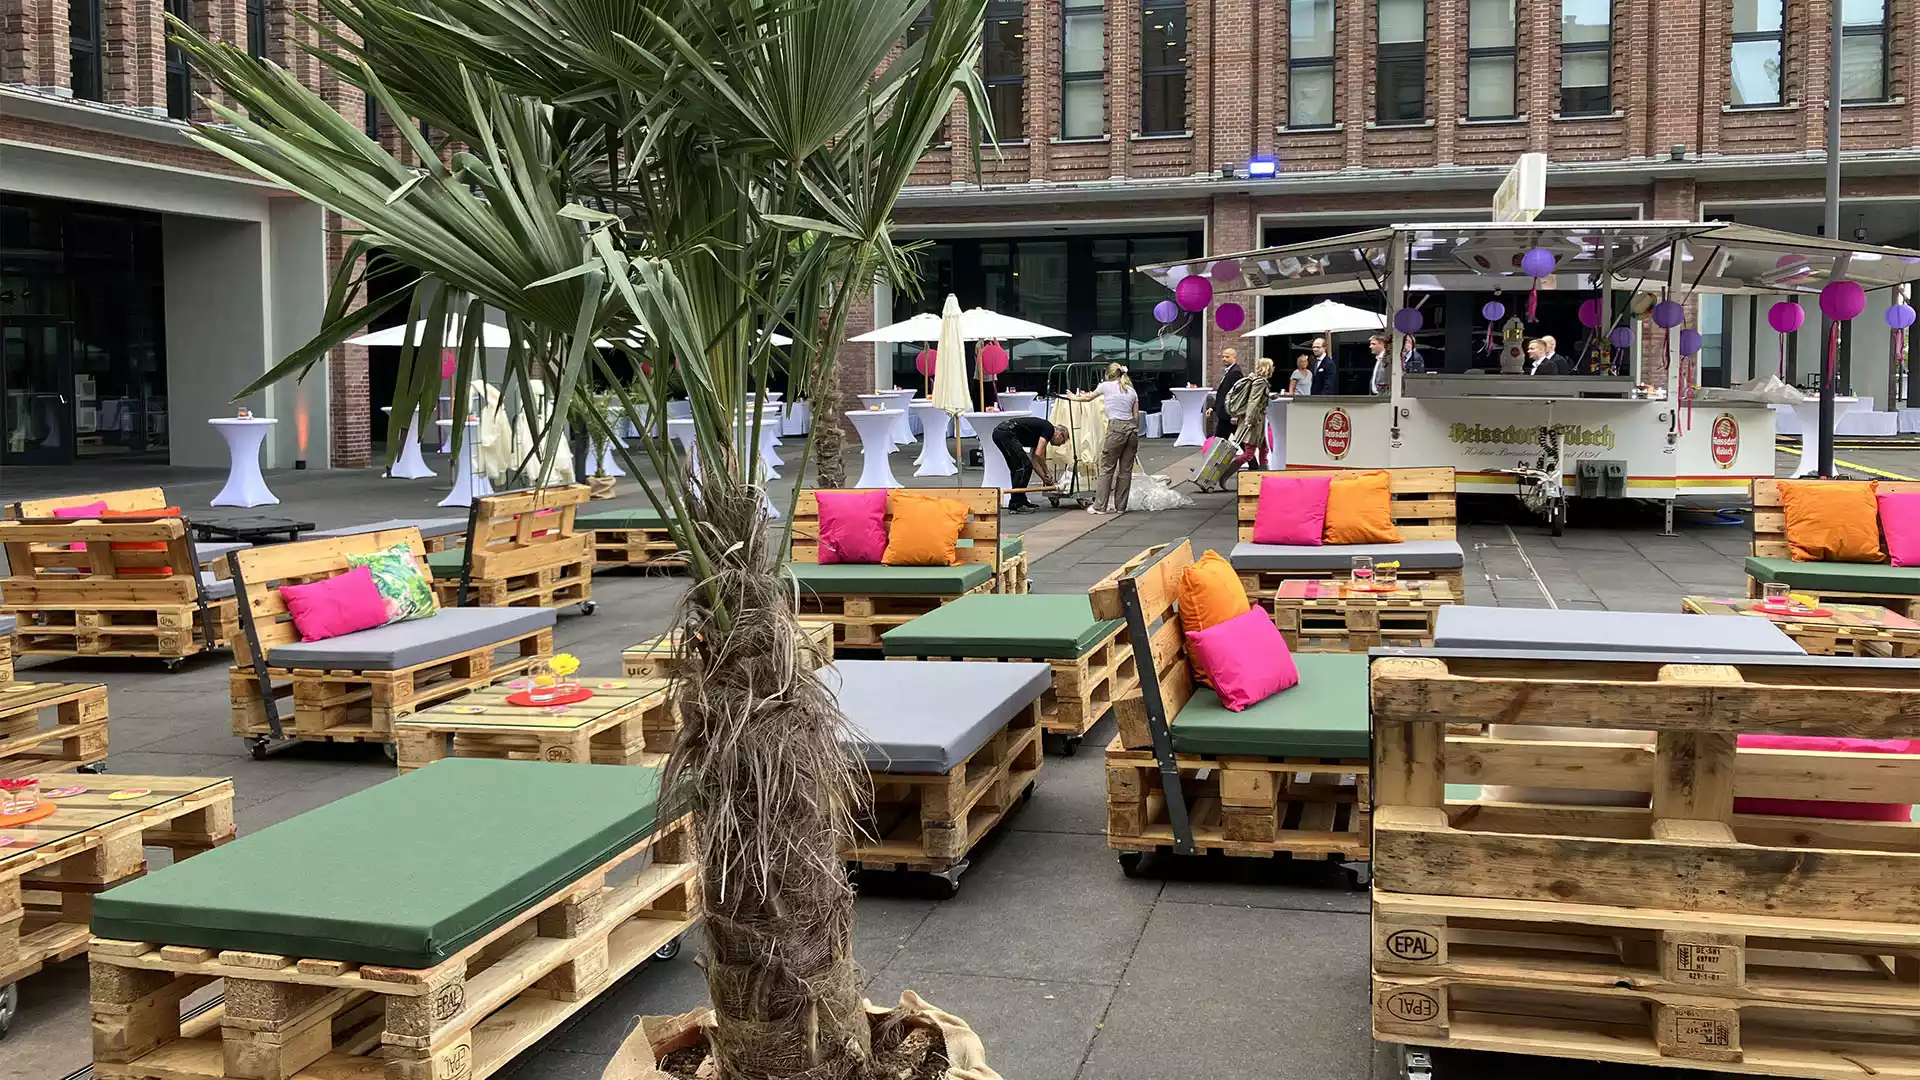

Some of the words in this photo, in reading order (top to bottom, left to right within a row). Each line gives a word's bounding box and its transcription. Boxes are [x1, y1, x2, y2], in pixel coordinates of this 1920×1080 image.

[1395, 935, 1433, 954] EPAL
[436, 990, 460, 1016] EPAL
[1397, 998, 1432, 1016] EPAL
[443, 1047, 466, 1077] EPAL
